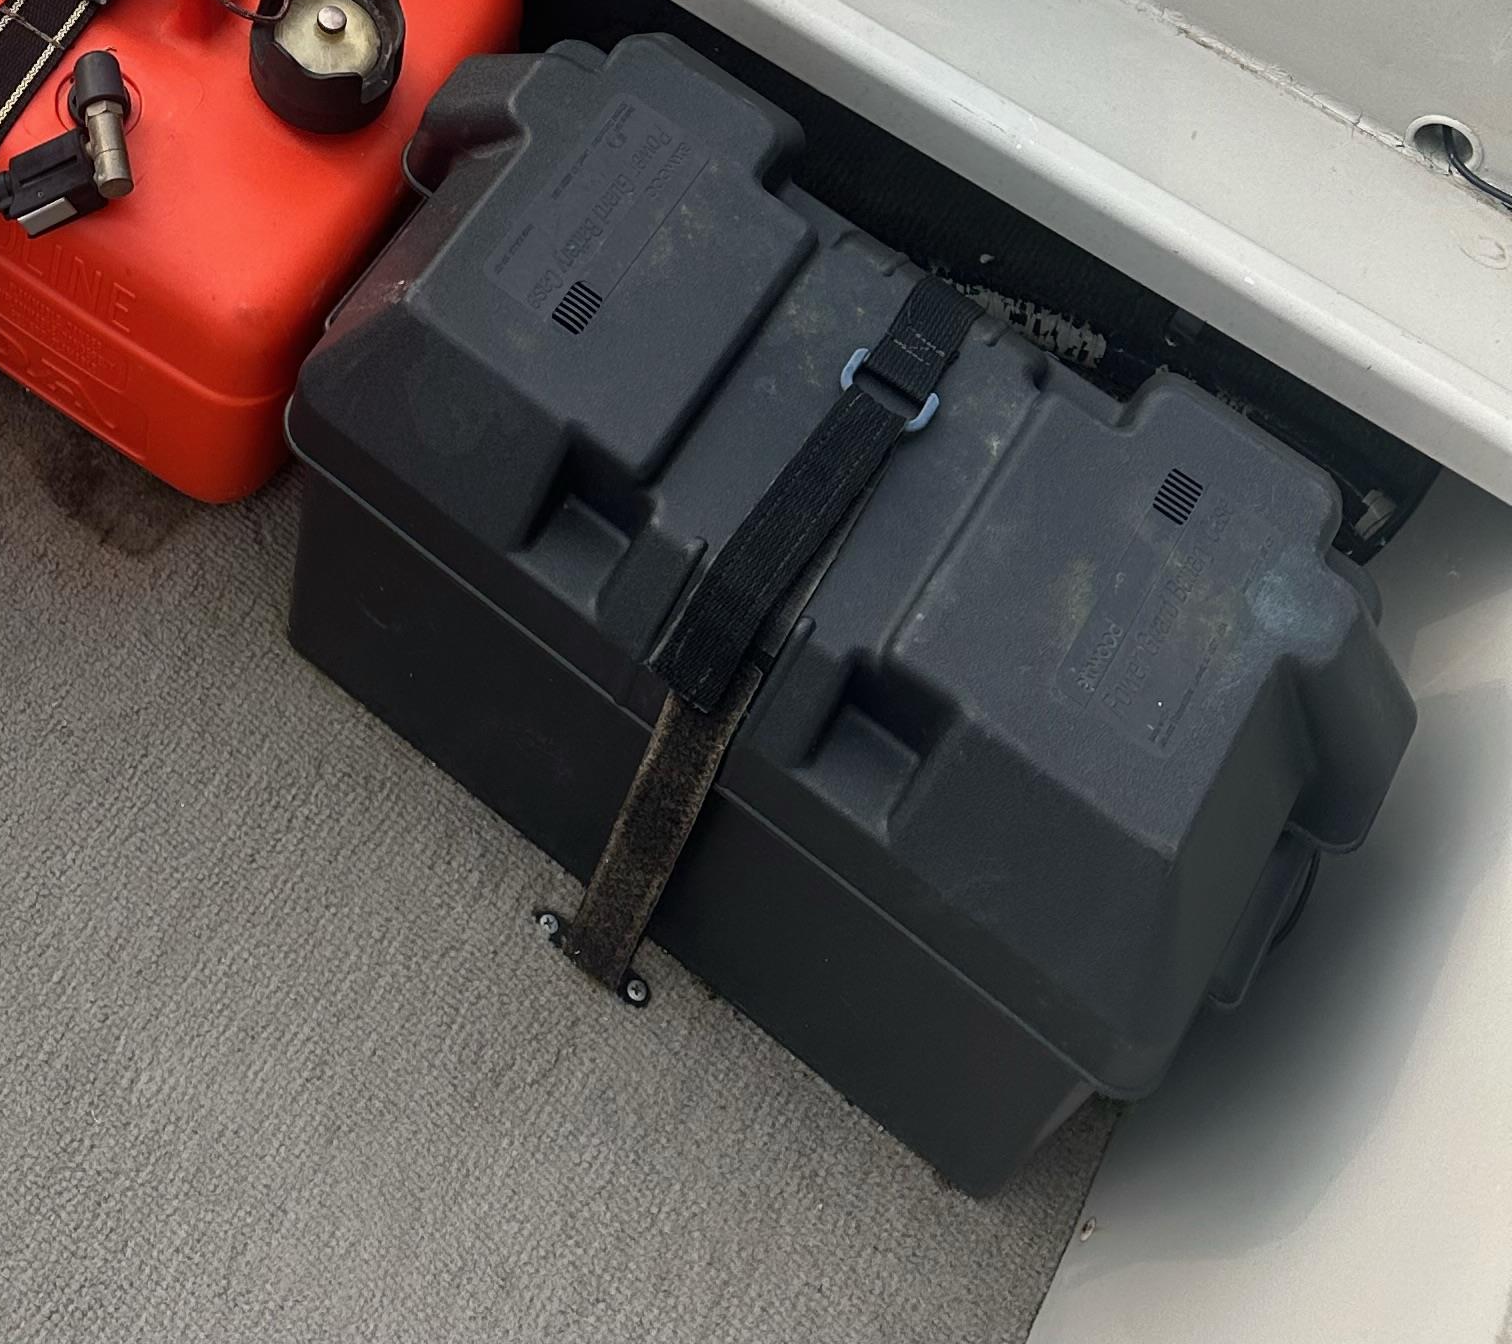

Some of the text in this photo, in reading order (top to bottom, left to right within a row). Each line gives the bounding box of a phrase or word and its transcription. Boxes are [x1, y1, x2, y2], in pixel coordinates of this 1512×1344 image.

[630, 127, 673, 176] Power
[591, 173, 635, 224] Guard
[553, 216, 604, 273] Battery
[527, 269, 564, 310] Case
